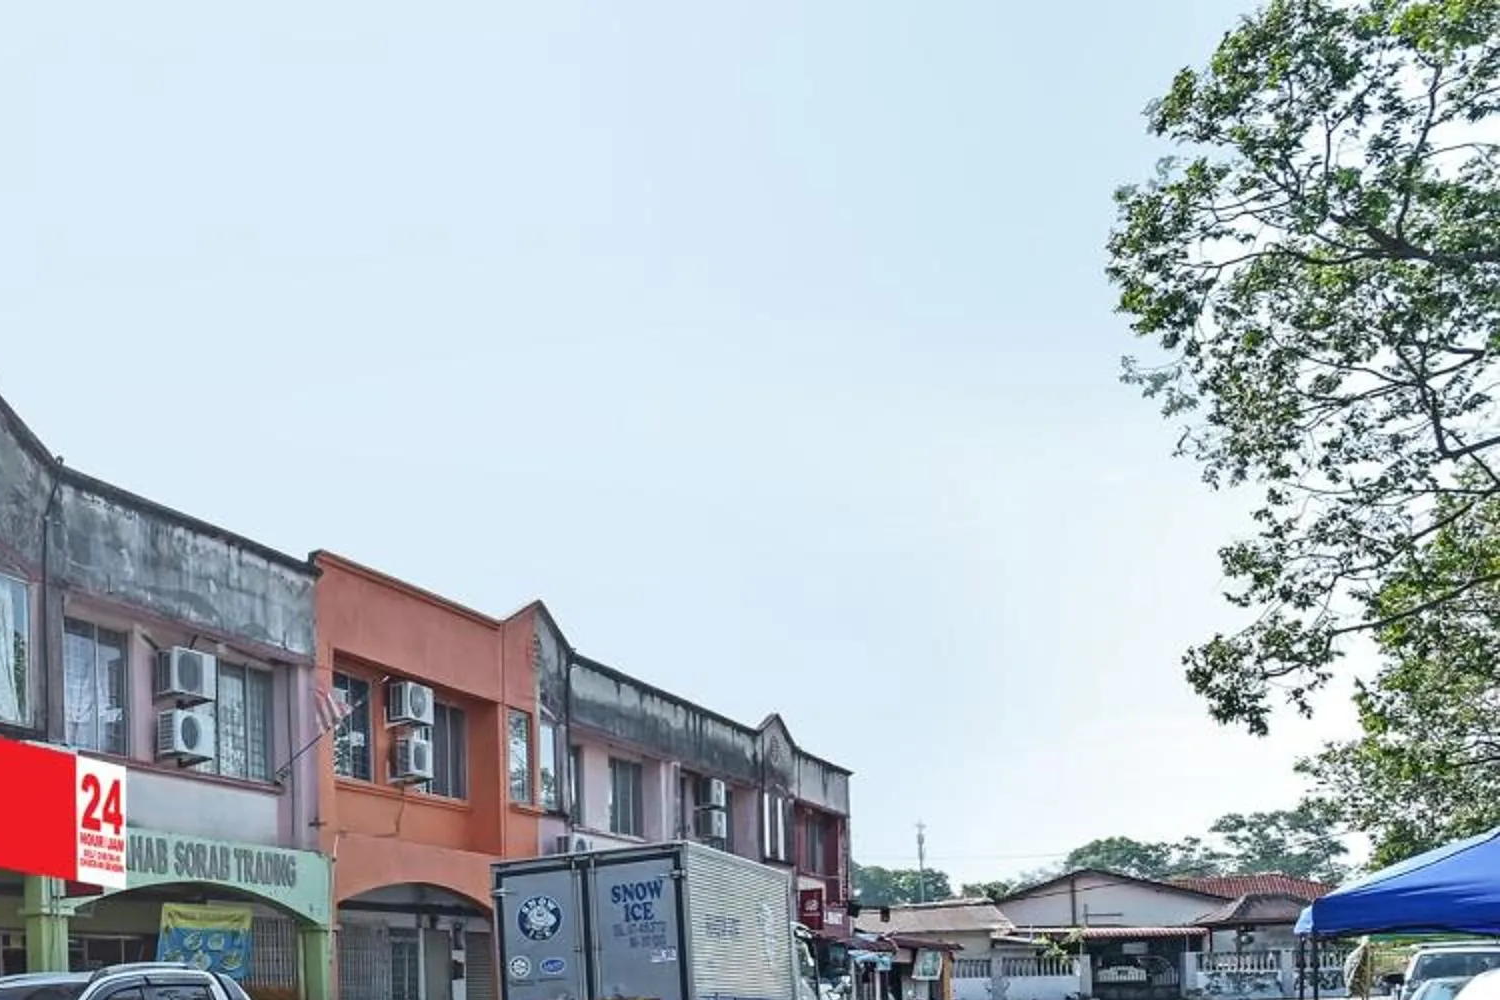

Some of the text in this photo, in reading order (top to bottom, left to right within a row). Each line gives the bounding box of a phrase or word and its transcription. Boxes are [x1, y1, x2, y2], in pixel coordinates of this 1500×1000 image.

[81, 772, 123, 835] 24
[174, 841, 230, 880] SORAB
[234, 848, 297, 888] TRADING
[611, 879, 664, 903] SNOW
[623, 902, 655, 922] ICE
